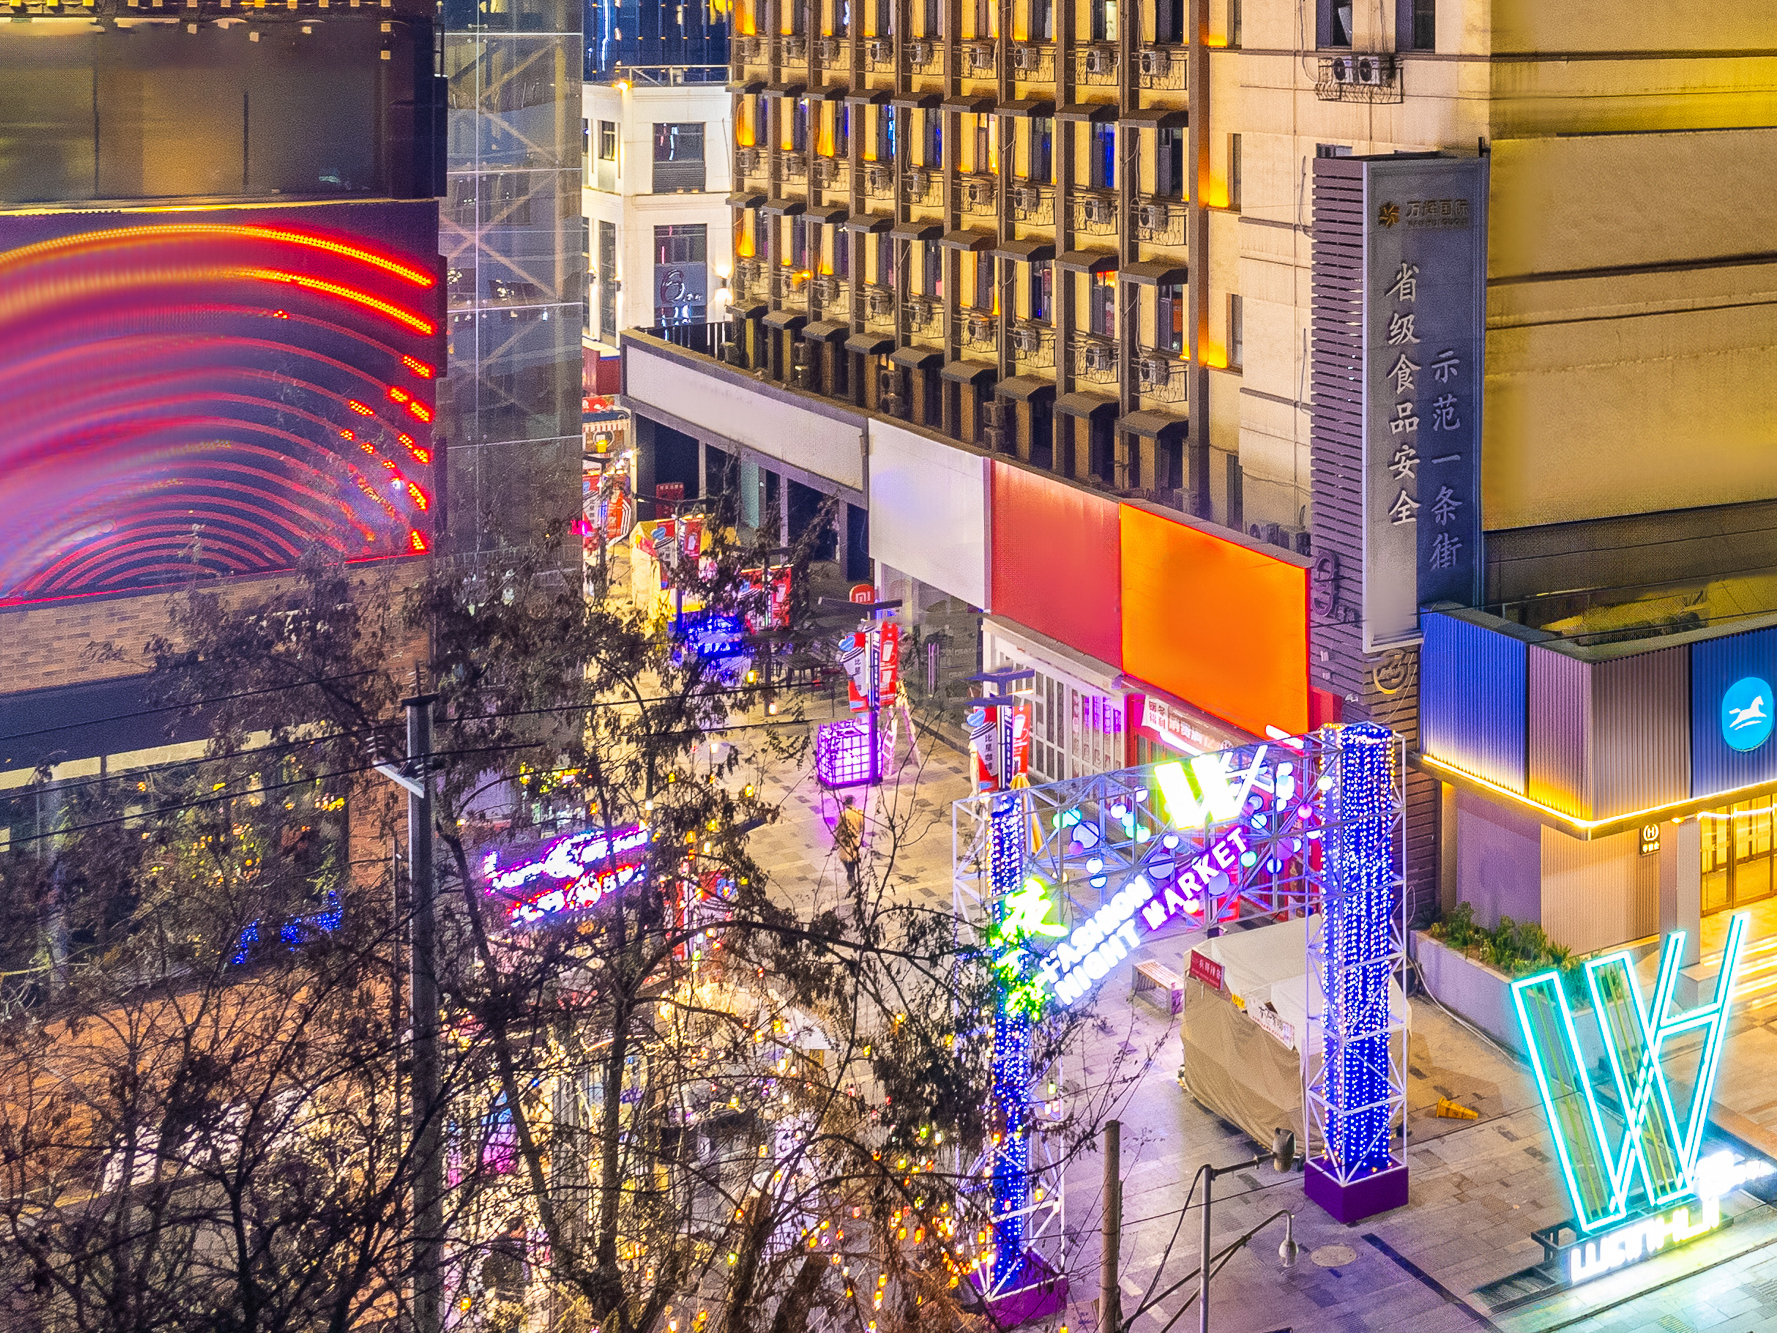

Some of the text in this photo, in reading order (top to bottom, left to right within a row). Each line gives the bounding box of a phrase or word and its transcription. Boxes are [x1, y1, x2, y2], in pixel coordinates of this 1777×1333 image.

[1406, 198, 1468, 218] 万辉国际
[1386, 262, 1420, 526] 省级食品安全
[1430, 349, 1463, 570] 示范一条街
[1142, 827, 1247, 931] MARKET
[1055, 919, 1140, 1005] NIGHT
